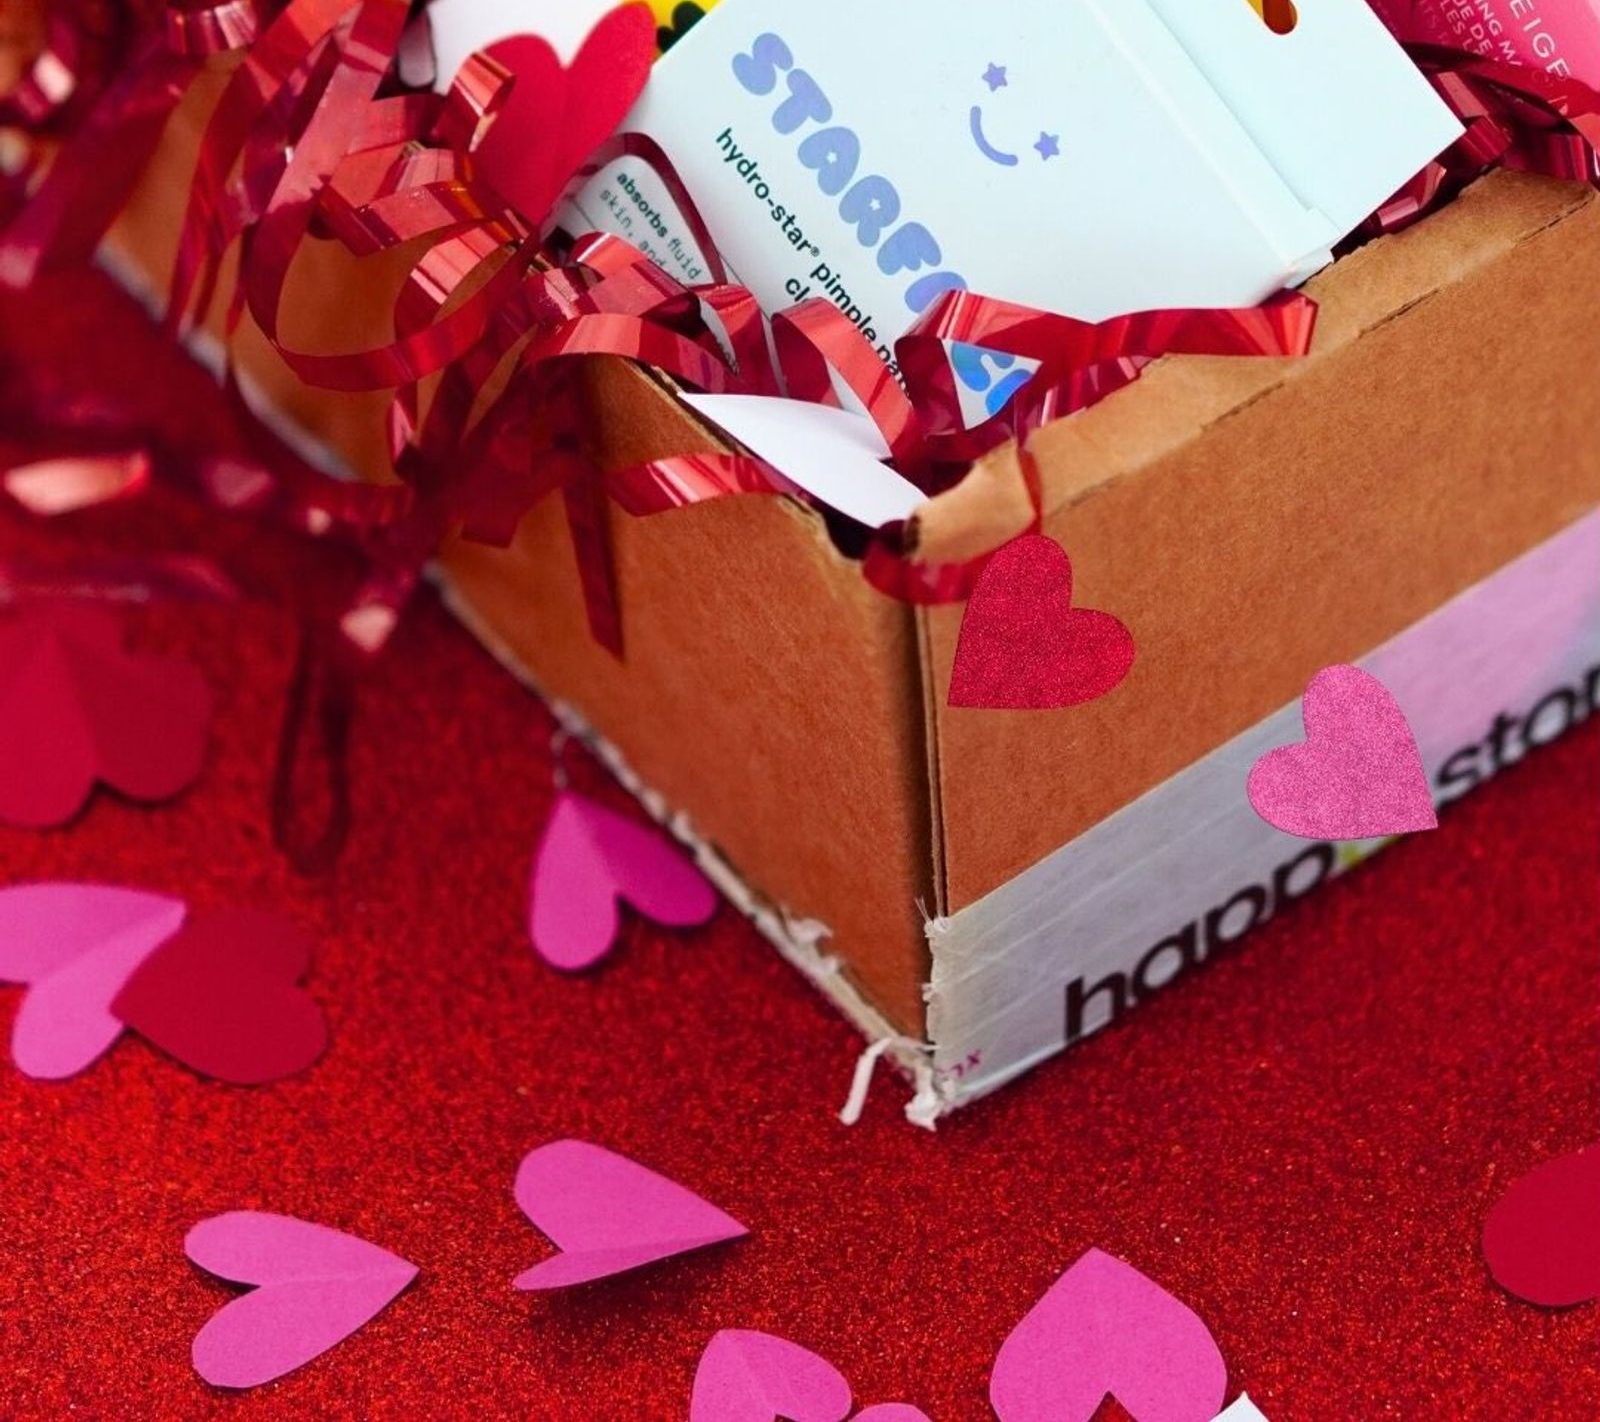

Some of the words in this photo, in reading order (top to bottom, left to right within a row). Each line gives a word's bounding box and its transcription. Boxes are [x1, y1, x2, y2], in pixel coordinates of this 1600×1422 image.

[1470, 23, 1494, 55] DE
[600, 188, 634, 238] skin,
[615, 172, 669, 239] absorbs
[666, 237, 704, 280] fluid
[810, 261, 877, 345] pimple
